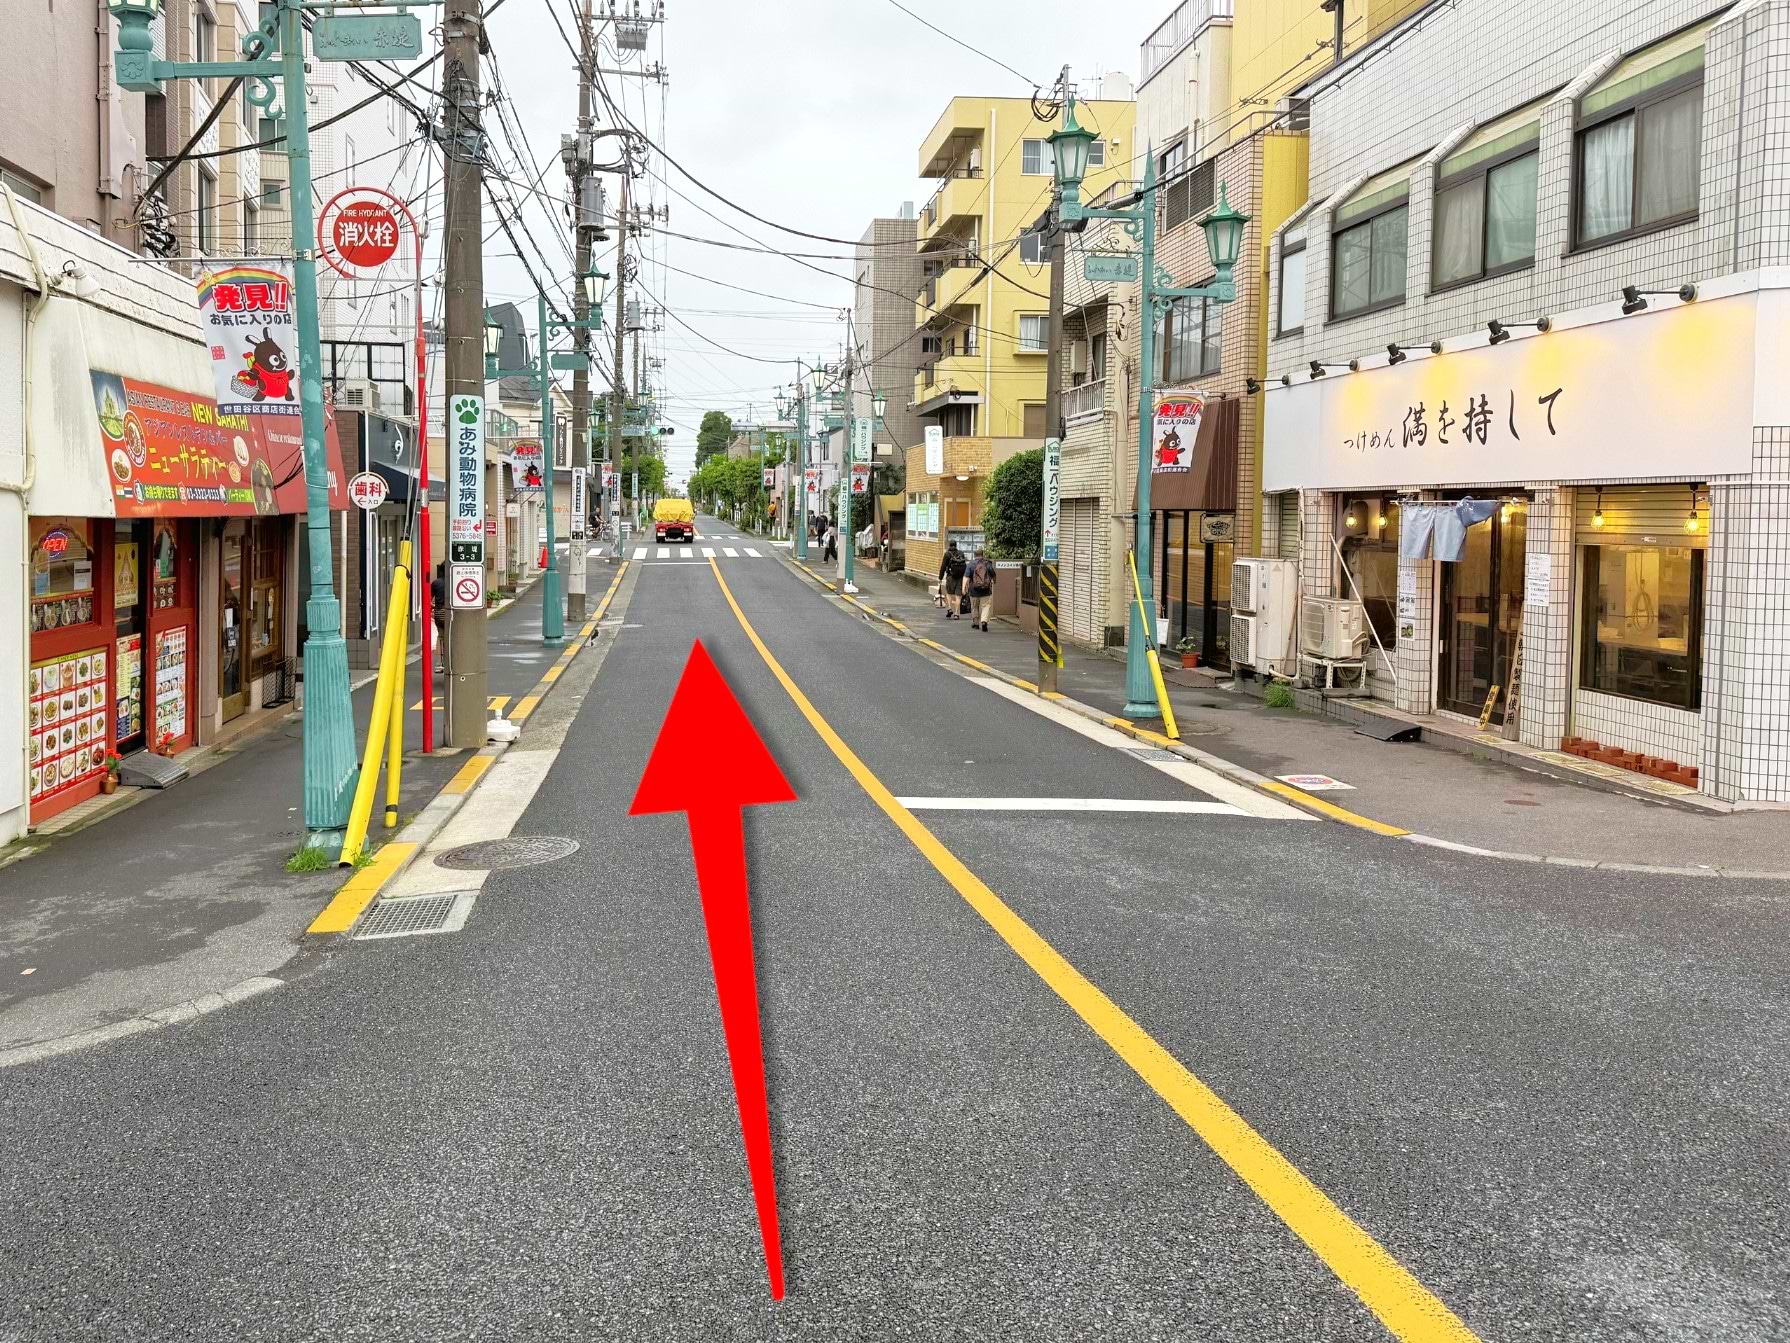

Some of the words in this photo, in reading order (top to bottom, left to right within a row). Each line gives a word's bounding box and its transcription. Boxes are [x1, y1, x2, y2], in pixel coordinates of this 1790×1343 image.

[343, 209, 357, 217] FIRE
[358, 209, 387, 217] HYDRANT
[338, 221, 395, 247] 消火栓
[209, 313, 292, 327] お気に入りの店
[191, 402, 213, 425] NEW
[223, 403, 301, 416] 世田谷区商店街連合
[1343, 428, 1396, 453] つけめん
[1402, 387, 1563, 449] 満を持して
[458, 426, 477, 518] あみ動物病院
[354, 481, 382, 497] 歯科
[1049, 455, 1060, 528] 福一ハウジング
[43, 538, 69, 552] OPEN
[459, 553, 476, 561] 3-3
